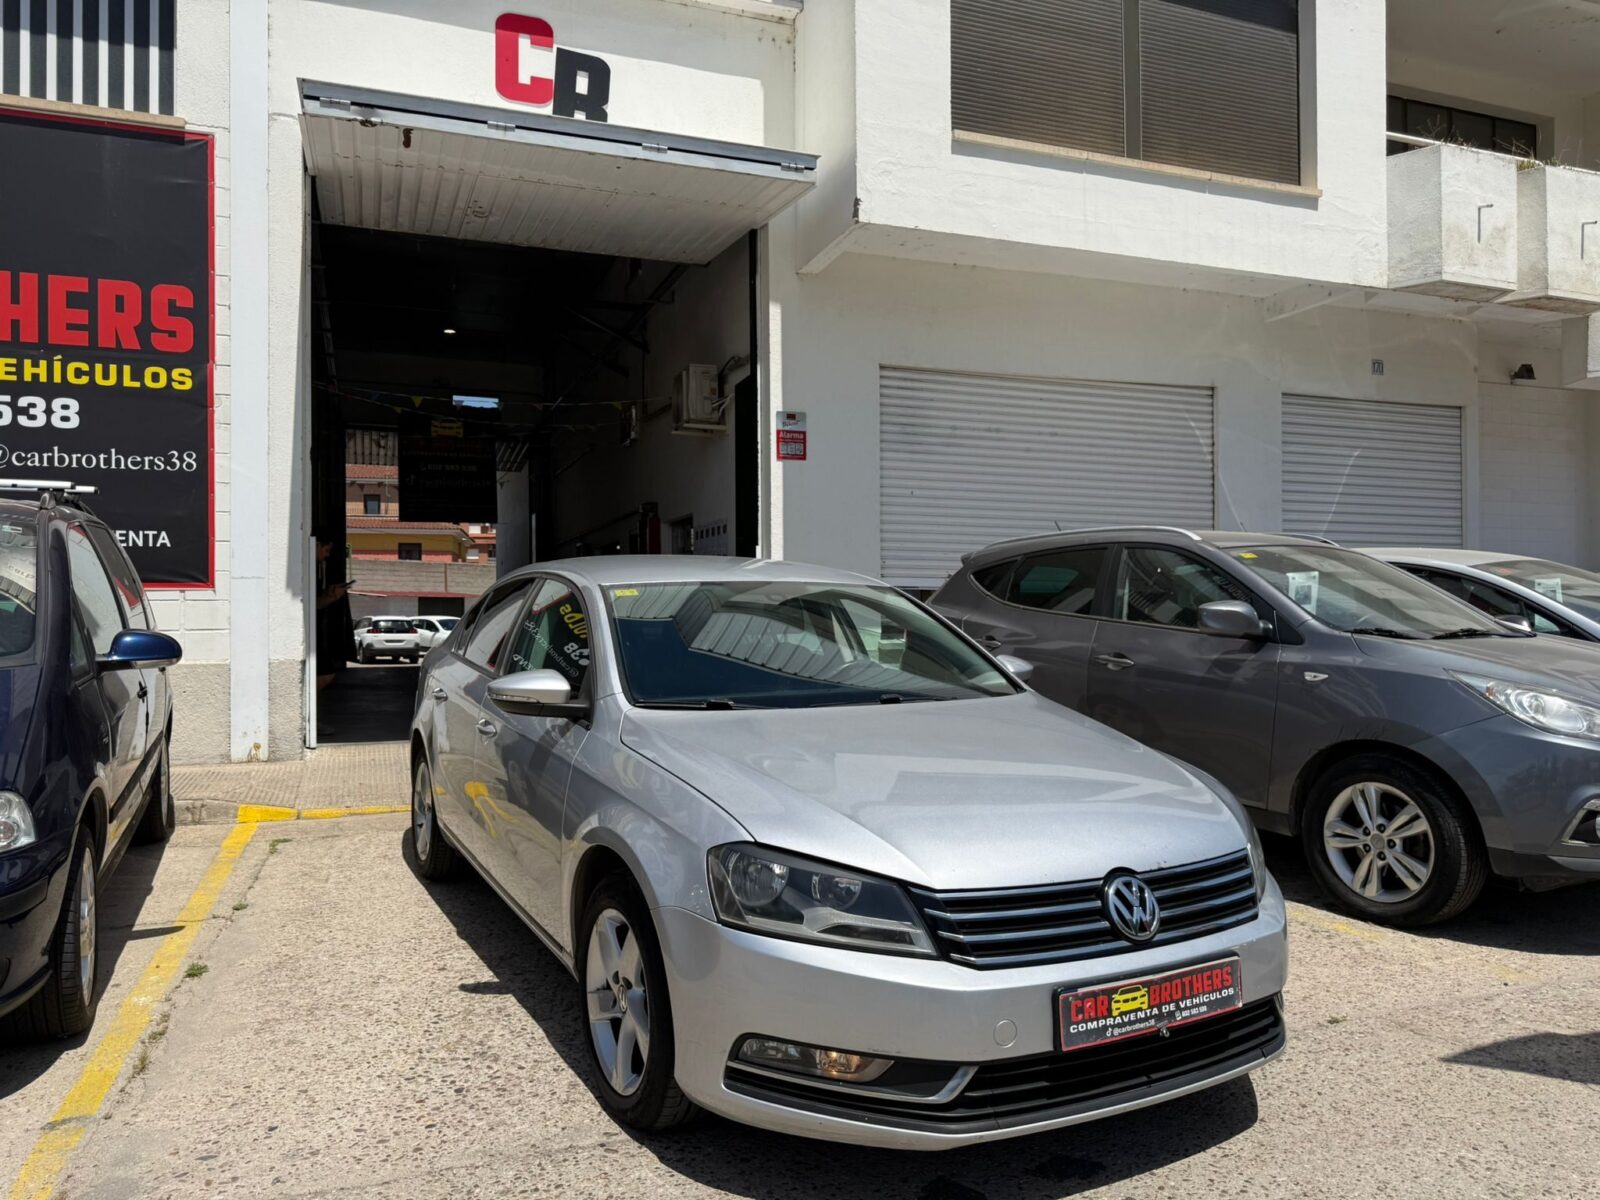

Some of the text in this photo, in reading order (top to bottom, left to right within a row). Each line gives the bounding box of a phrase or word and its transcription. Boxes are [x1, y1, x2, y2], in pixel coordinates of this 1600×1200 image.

[0, 270, 194, 353] HERS
[0, 354, 193, 391] EHÍCULOS
[780, 431, 803, 439] Alarma
[112, 530, 171, 547] ENTA
[1069, 987, 1235, 1034] COMPRAVENTA DE VEHÍCULOS
[1070, 965, 1233, 1023] CAR BROTHERS
